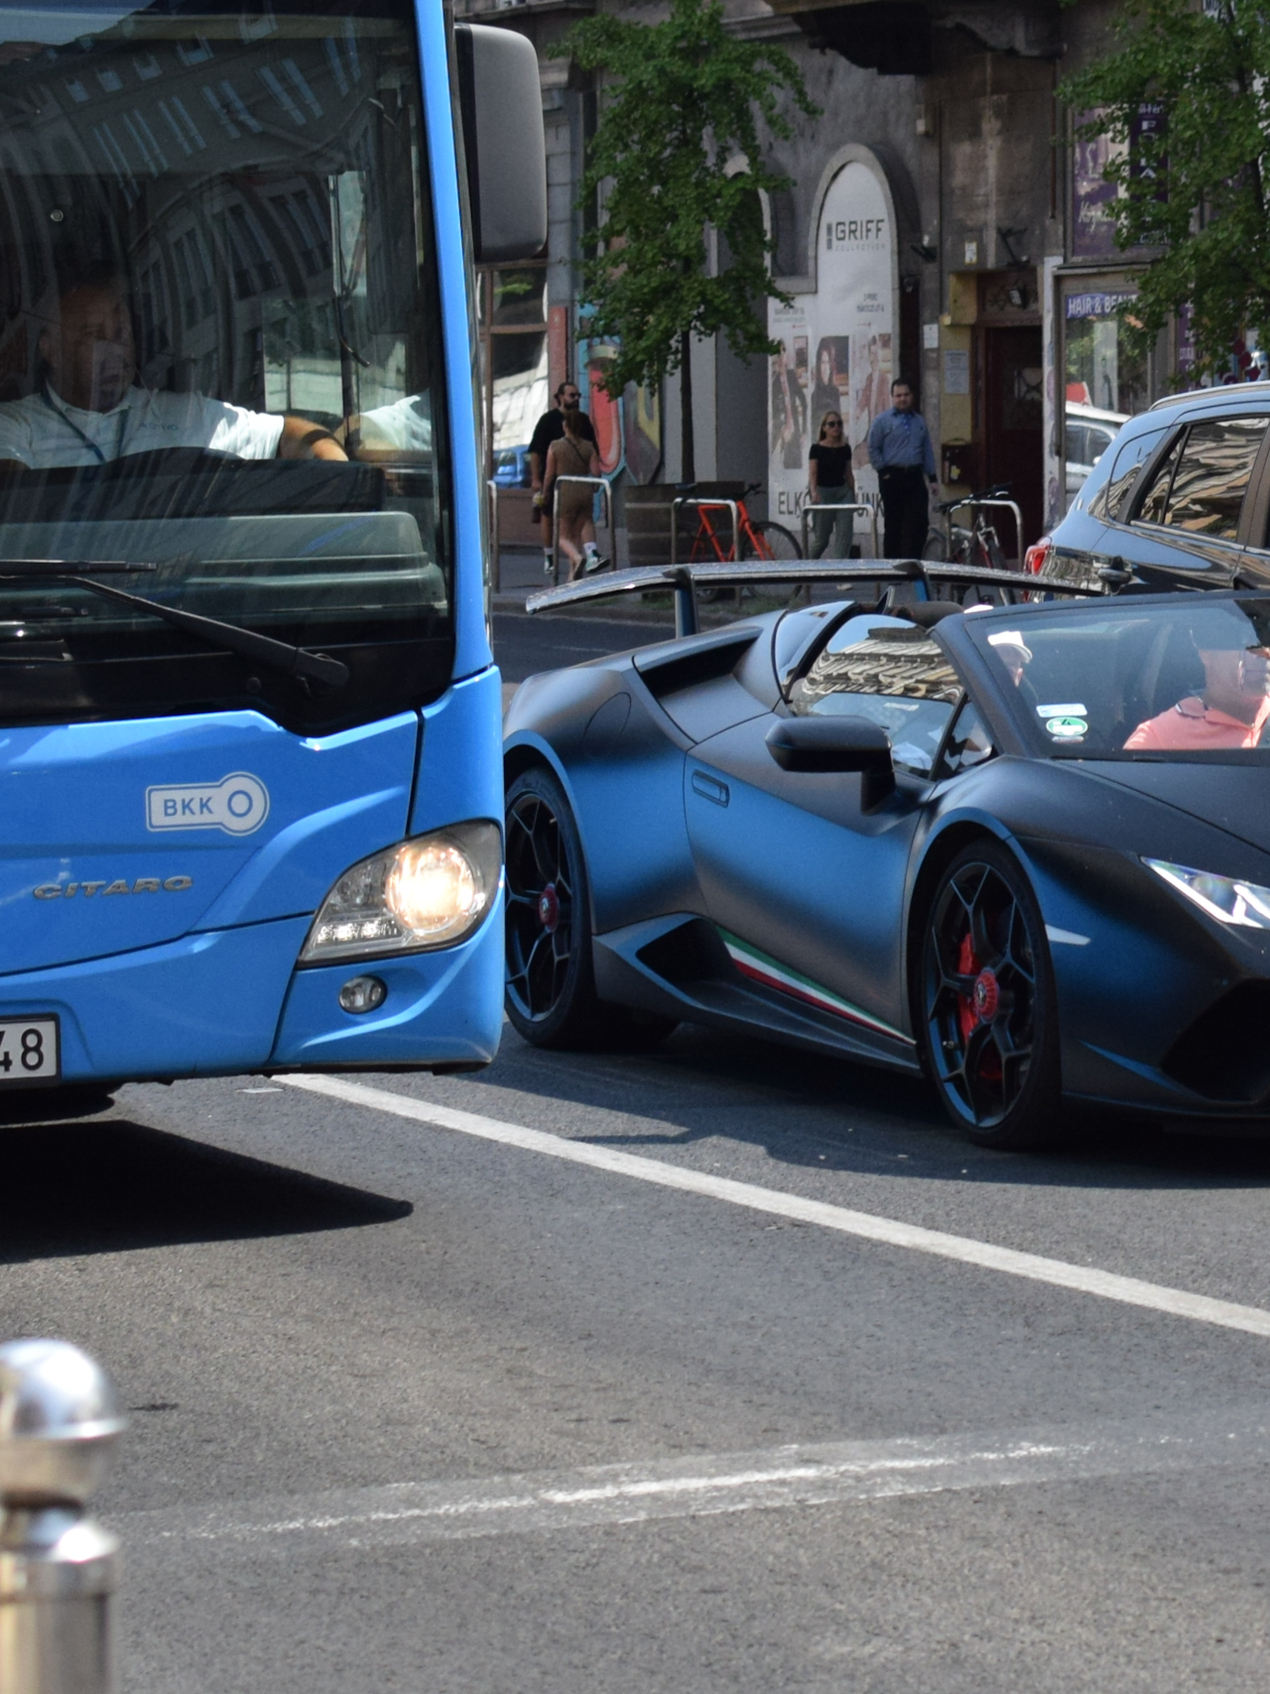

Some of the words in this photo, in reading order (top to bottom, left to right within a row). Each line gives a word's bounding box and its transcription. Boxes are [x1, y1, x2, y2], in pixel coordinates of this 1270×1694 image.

[835, 219, 885, 241] GRIFF
[1068, 297, 1092, 315] HAIR
[163, 797, 214, 817] BKK
[33, 875, 194, 900] CITARO
